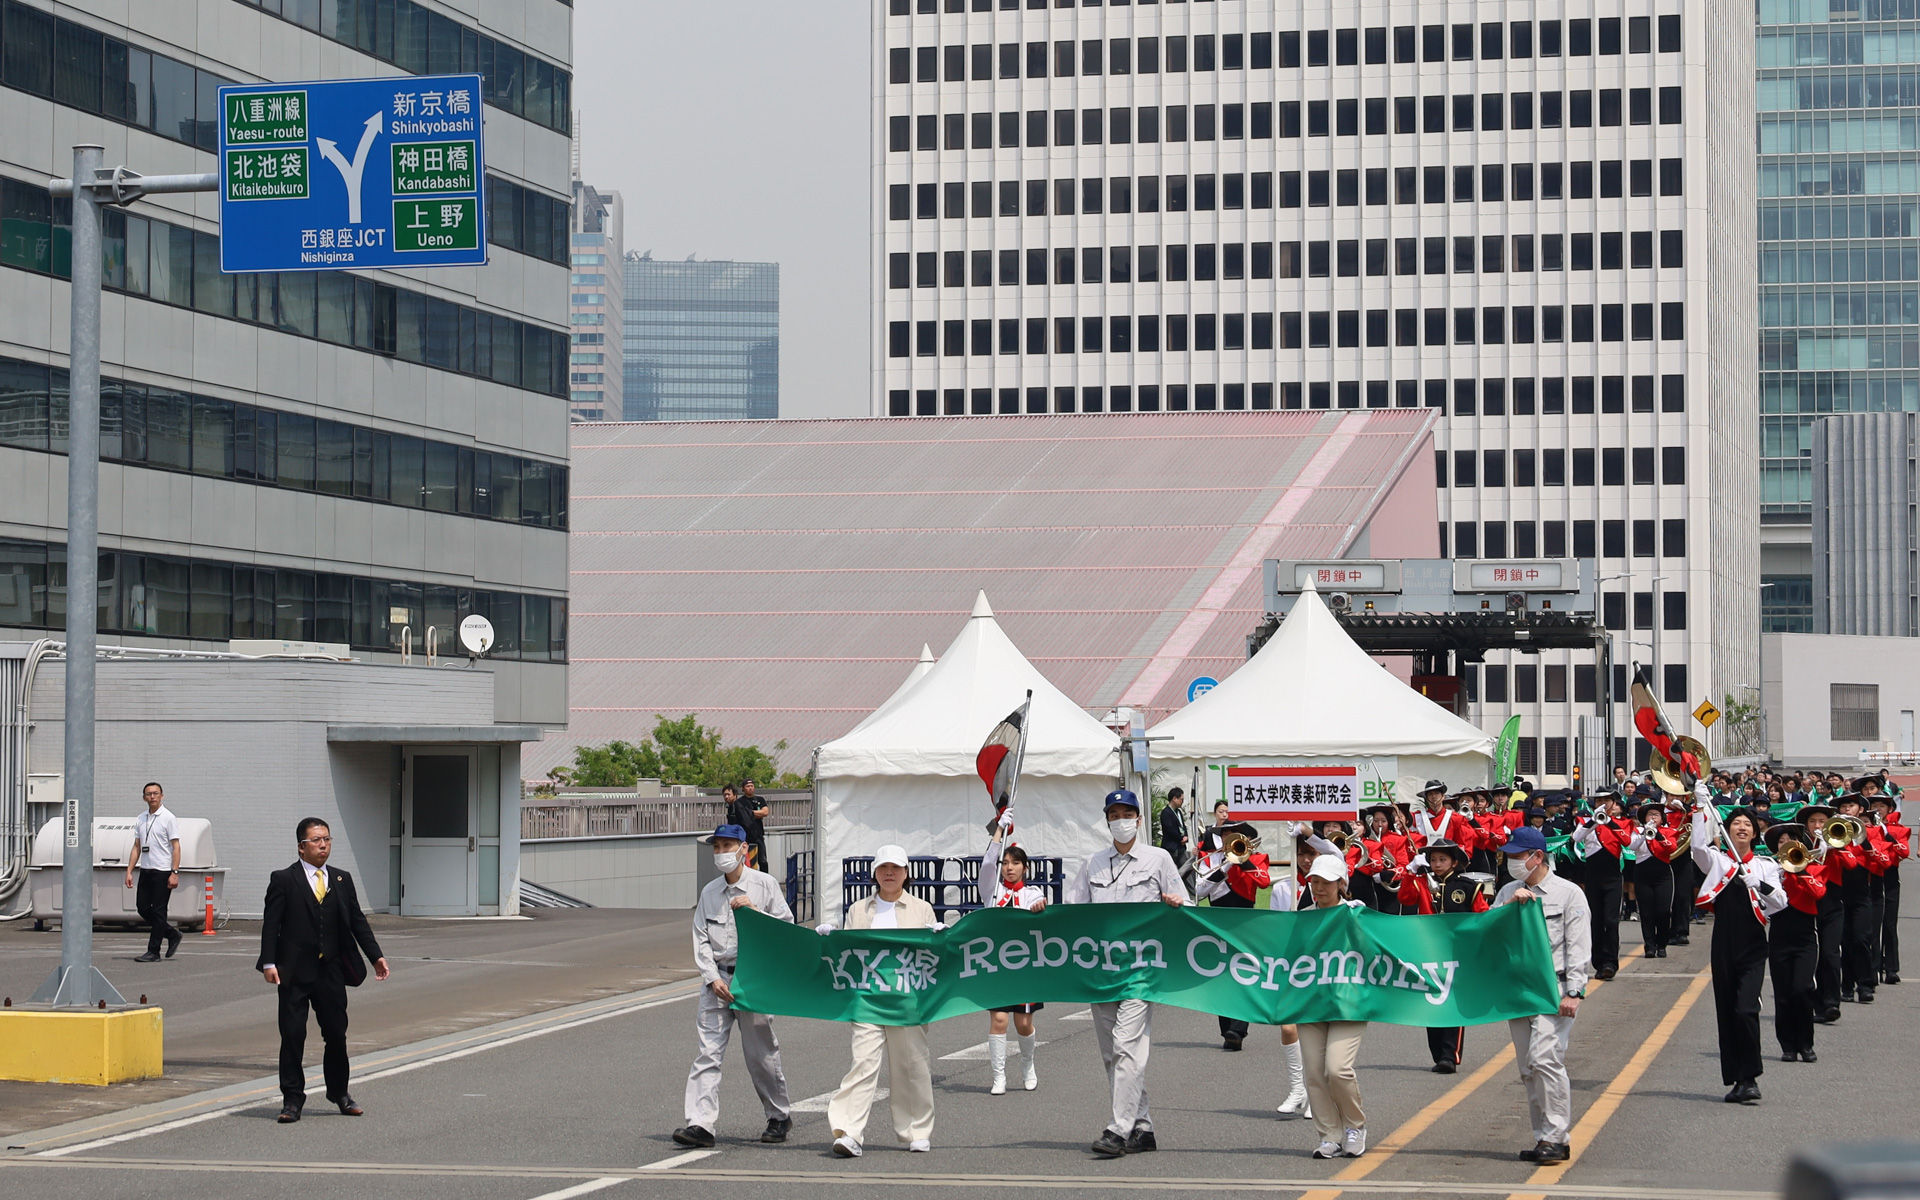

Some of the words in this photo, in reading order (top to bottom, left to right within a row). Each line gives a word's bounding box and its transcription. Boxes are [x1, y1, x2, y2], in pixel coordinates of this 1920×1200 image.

[233, 97, 301, 123] 八重洲線
[393, 89, 471, 117] 新京橋
[230, 126, 304, 142] Yaesu-route
[391, 118, 474, 136] Shinkyobashi
[233, 153, 302, 179] 北池袋
[399, 146, 468, 173] 神田橋
[232, 183, 303, 197] Kitaikebukuro
[398, 175, 470, 190] Kandabashi
[407, 204, 463, 229] 上野
[301, 227, 386, 249] 西銀座JCT
[417, 233, 453, 247] Ueno
[301, 251, 354, 263] Nishiginza
[1317, 569, 1362, 583] 閉鎖中
[1493, 568, 1539, 582] 閉鎖中
[1233, 784, 1352, 805] 日本大学吹奏楽研究会
[959, 930, 1167, 979] Reborn
[1186, 935, 1460, 1006] Ceremony
